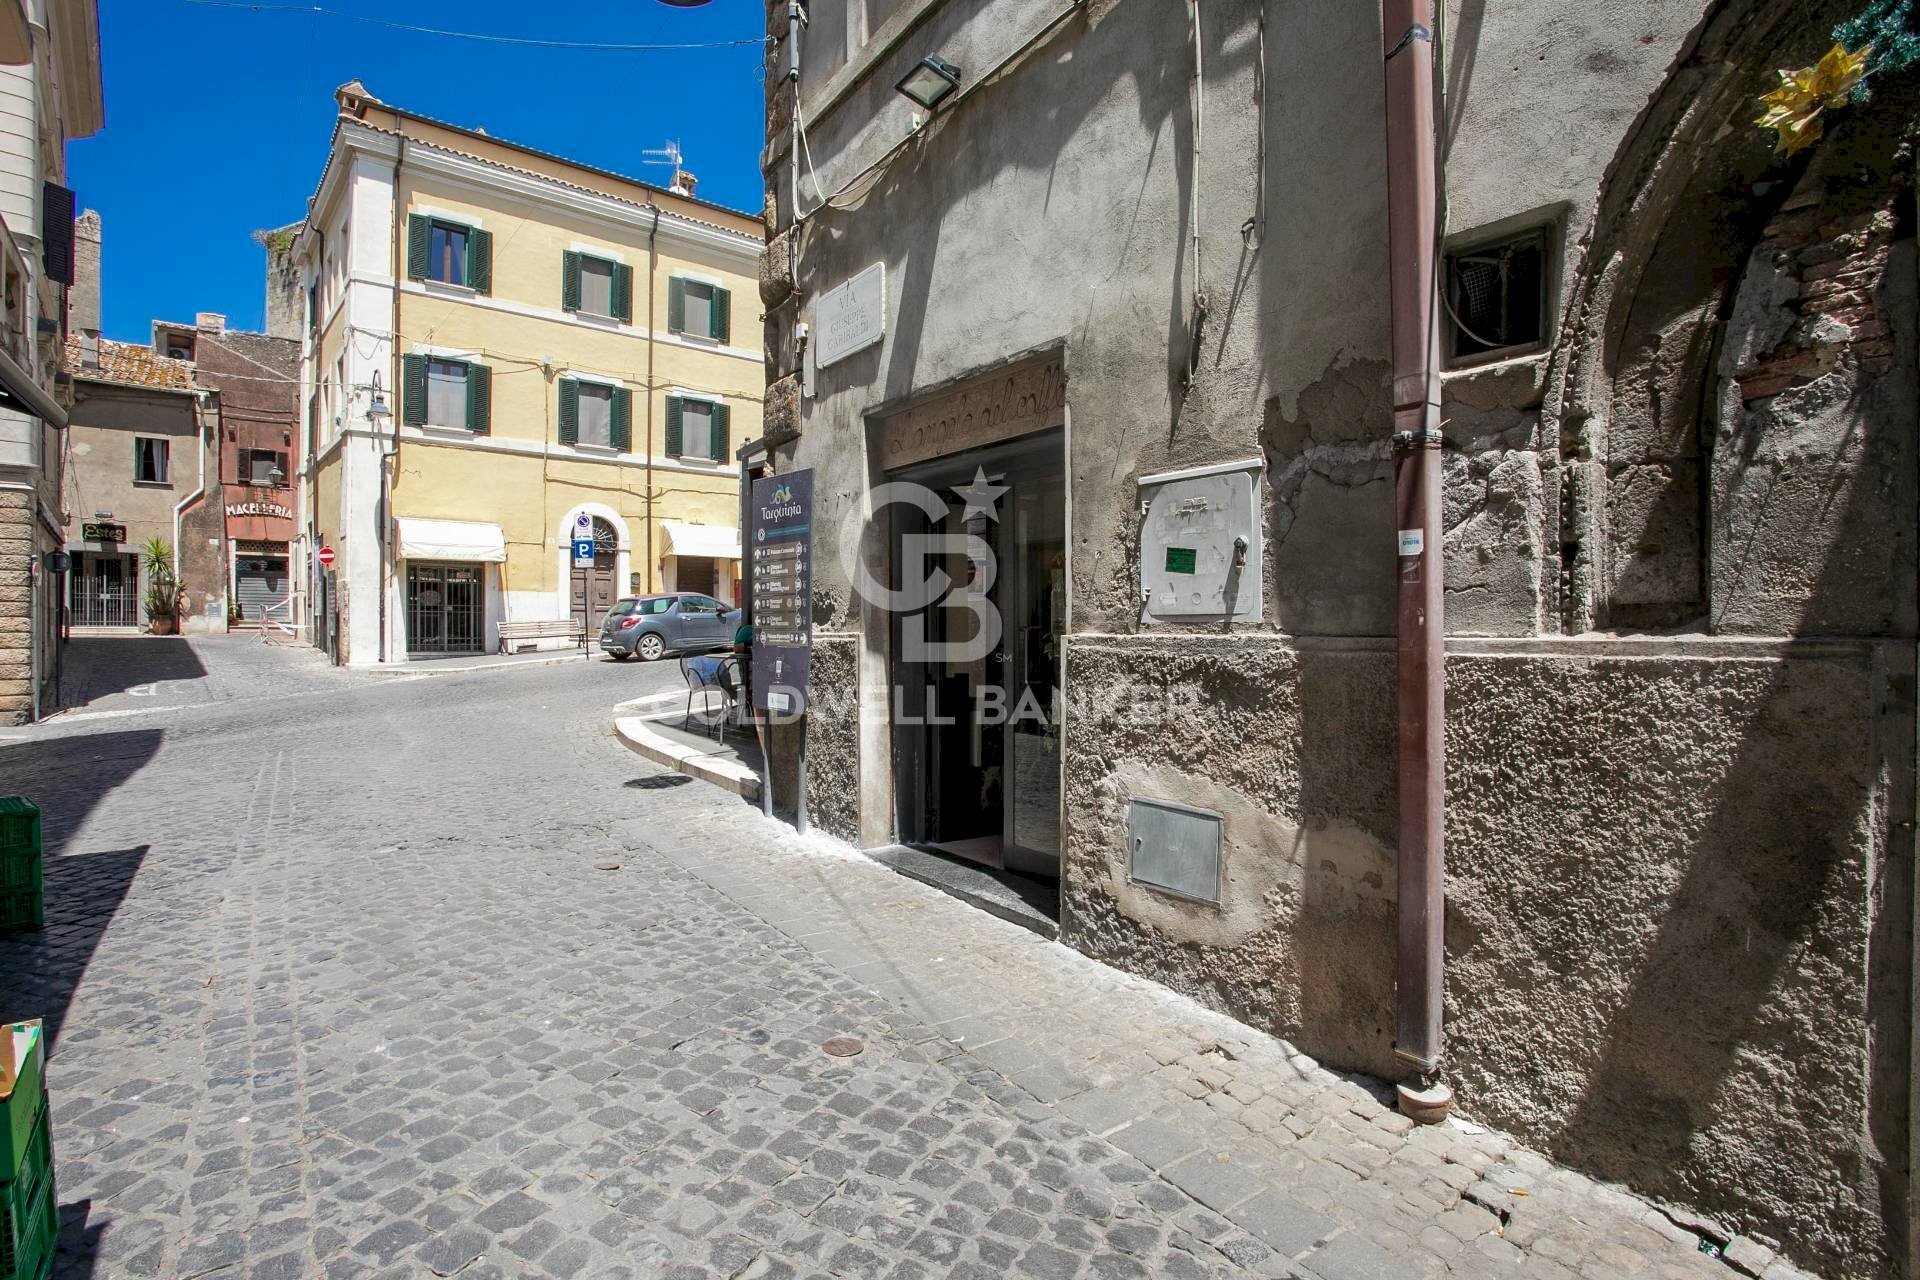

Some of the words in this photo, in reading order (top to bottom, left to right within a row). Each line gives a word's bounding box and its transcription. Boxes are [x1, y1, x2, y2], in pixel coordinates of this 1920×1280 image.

[839, 290, 857, 310] VIA
[226, 502, 292, 519] MACELLERIA
[760, 501, 803, 523] Tarquinia
[84, 525, 124, 541] Estes
[578, 543, 590, 557] P
